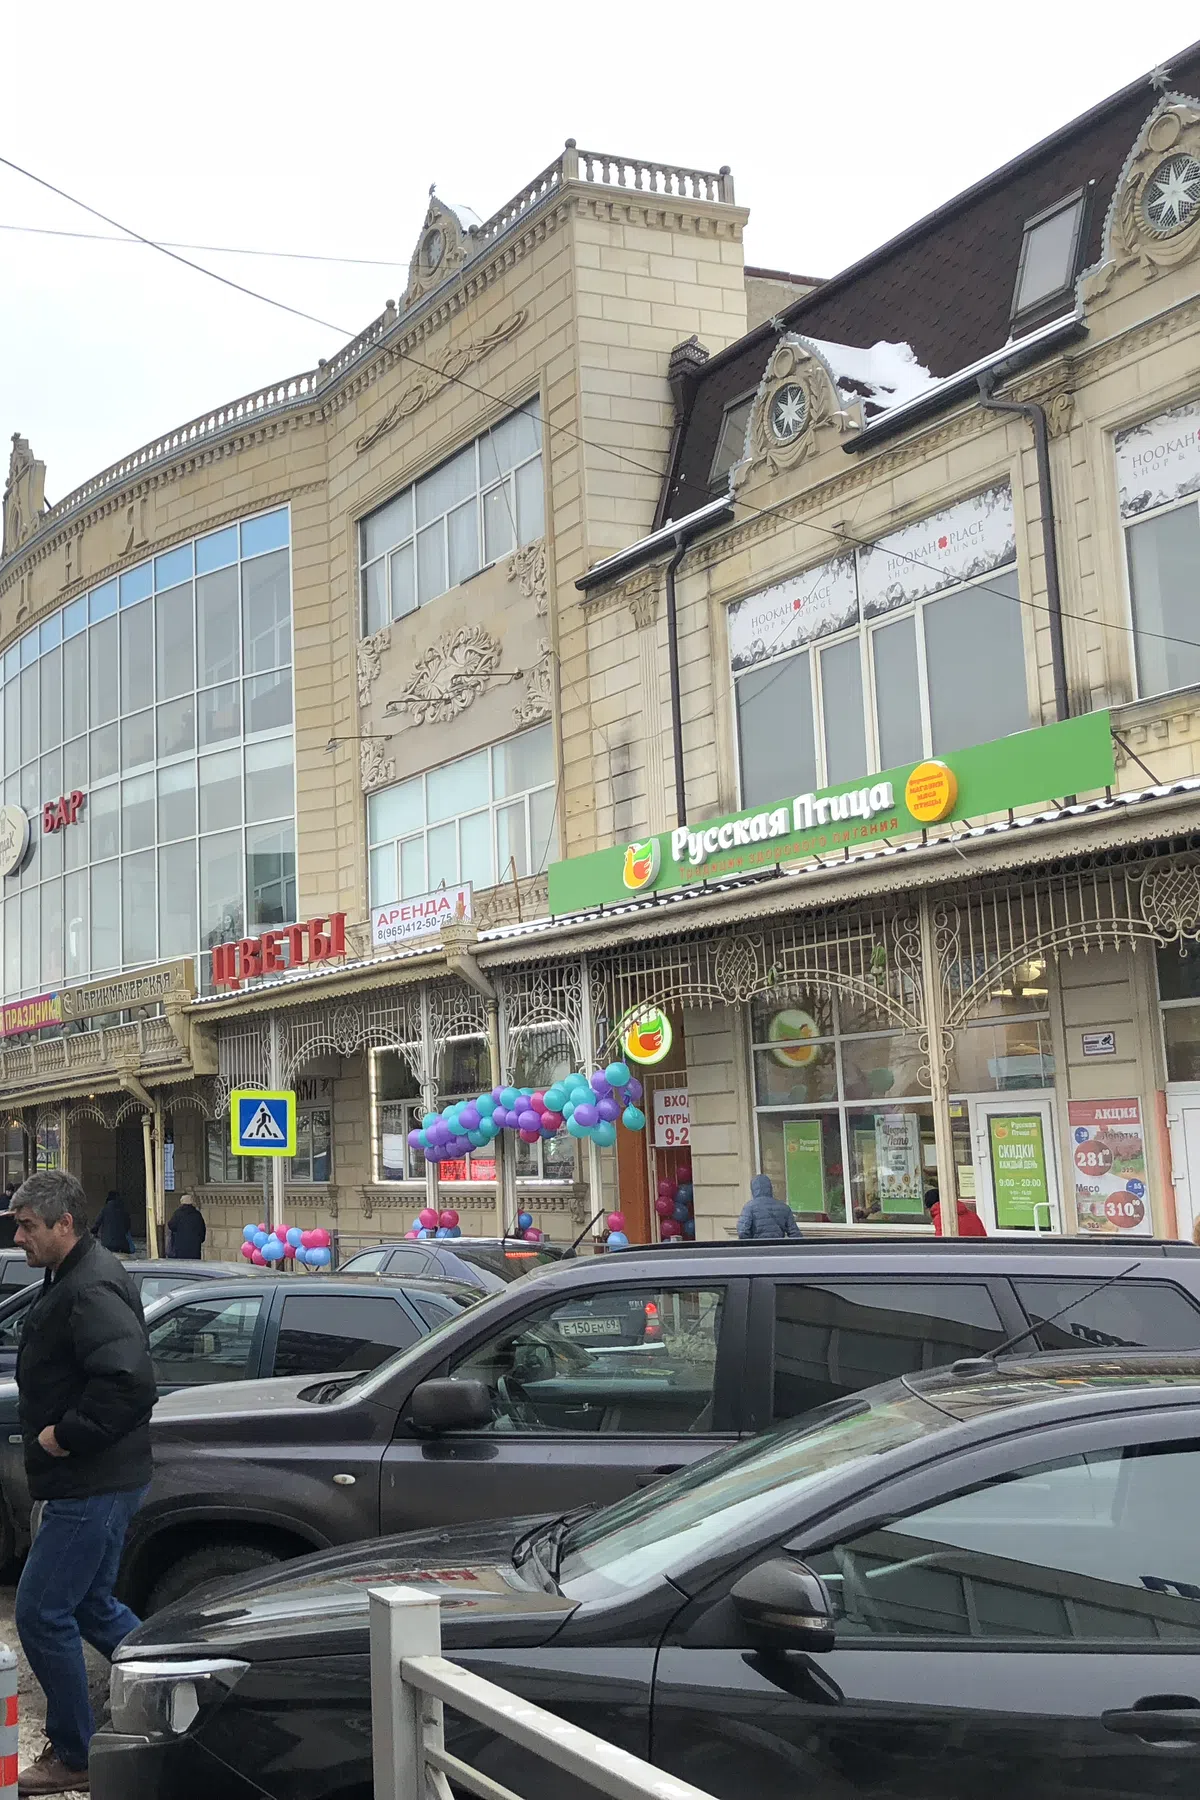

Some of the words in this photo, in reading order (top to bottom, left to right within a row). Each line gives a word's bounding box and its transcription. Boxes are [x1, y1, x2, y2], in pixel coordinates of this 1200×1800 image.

[1132, 431, 1195, 468] HOOKAH
[1133, 458, 1169, 479] SHOP
[886, 541, 937, 572] HOOKAH
[949, 520, 985, 545] PLACE
[887, 564, 917, 580] SHOP
[936, 535, 987, 561] LOUNGE
[750, 604, 793, 629] HOOKAH
[802, 585, 831, 607] PLACE
[751, 623, 776, 636] SHOP
[794, 599, 832, 620] LOUNGE
[43, 789, 84, 833] БАР
[671, 806, 790, 865] Русская
[793, 781, 895, 832] Птица
[679, 855, 744, 880] Традиции
[748, 837, 827, 864] здорового
[833, 817, 899, 844] питания
[377, 897, 451, 927] АРЕНДА
[377, 912, 453, 940] 8(965)412-50-75
[211, 912, 347, 990] ЦВЕТЫ
[5, 996, 62, 1033] ПРАЗДНИКА
[657, 1112, 690, 1126] ОТКРЫ
[1094, 1107, 1138, 1121] АКЦИЯ
[665, 1127, 689, 1146] 9-2
[1102, 1131, 1139, 1141] Лопатка
[998, 1144, 1035, 1160] СКИДКИ
[1023, 1160, 1038, 1170] ДЕНЬ
[1077, 1152, 1104, 1167] 281
[998, 1178, 1015, 1187] 9:00
[1021, 1178, 1041, 1187] 20:00
[1075, 1183, 1100, 1193] Мясо
[1106, 1202, 1135, 1217] 310
